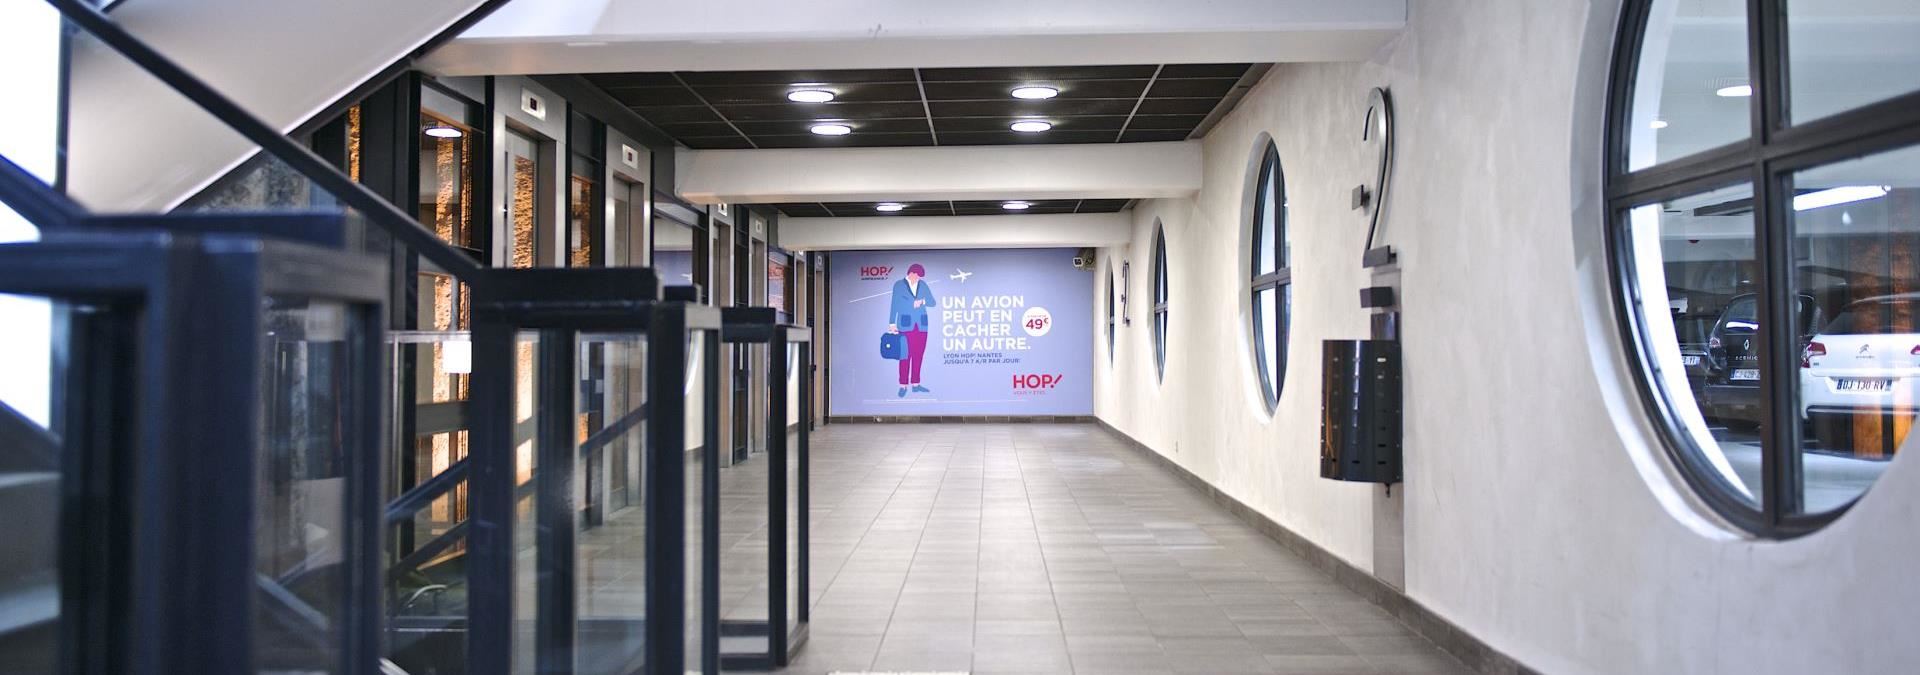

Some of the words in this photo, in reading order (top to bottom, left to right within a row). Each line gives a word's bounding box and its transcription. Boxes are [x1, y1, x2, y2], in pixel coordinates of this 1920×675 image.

[861, 266, 894, 276] HOP!
[942, 296, 965, 308] UN
[971, 295, 1024, 308] AVION
[943, 309, 985, 322] PEUT
[990, 309, 1012, 322] EN
[942, 324, 1011, 336] CACHER
[1026, 317, 1049, 330] 49€
[943, 338, 966, 350] UN
[971, 337, 1031, 350] AUTRE.
[1013, 374, 1062, 389] HOP!
